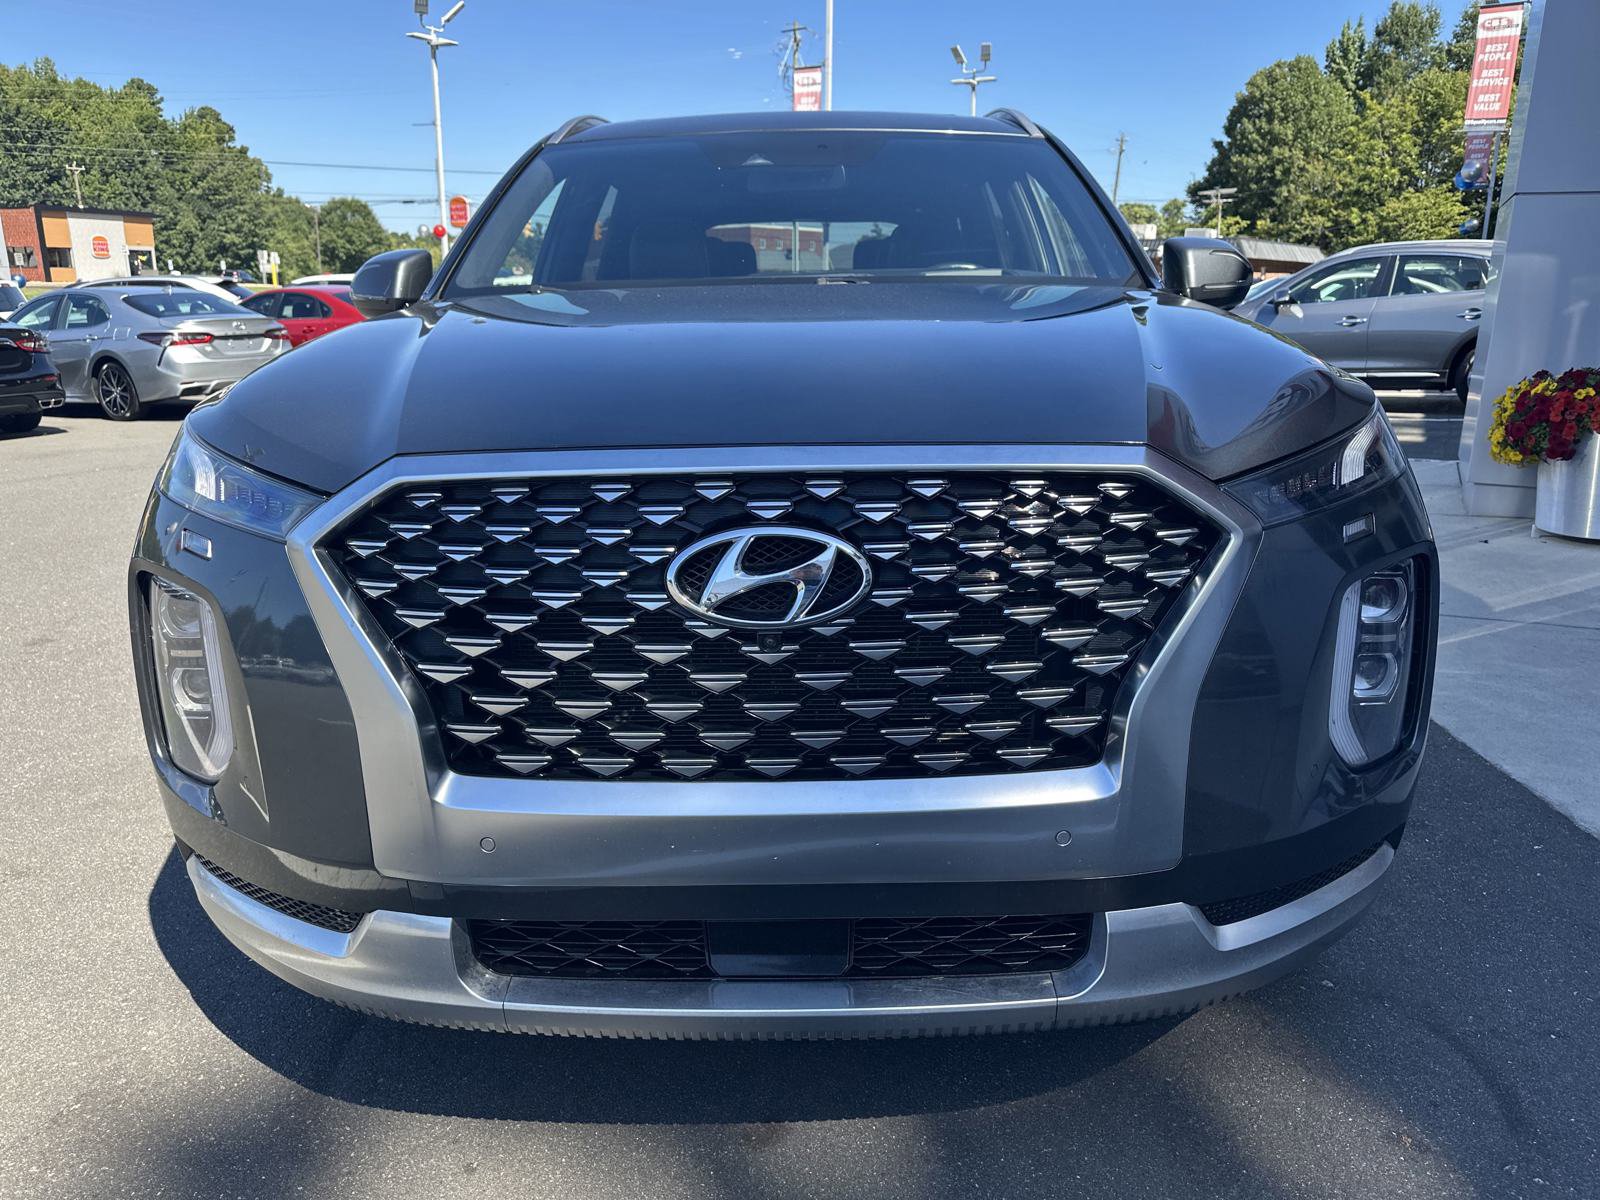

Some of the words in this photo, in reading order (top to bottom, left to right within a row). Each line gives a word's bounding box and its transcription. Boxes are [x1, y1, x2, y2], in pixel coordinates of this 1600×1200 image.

[1485, 43, 1508, 52] BEST
[1478, 52, 1512, 62] PEOPLE
[1481, 68, 1504, 77] BEST
[1472, 77, 1509, 87] SERVICE
[1477, 93, 1501, 103] BEST
[1474, 102, 1501, 111] VALUE
